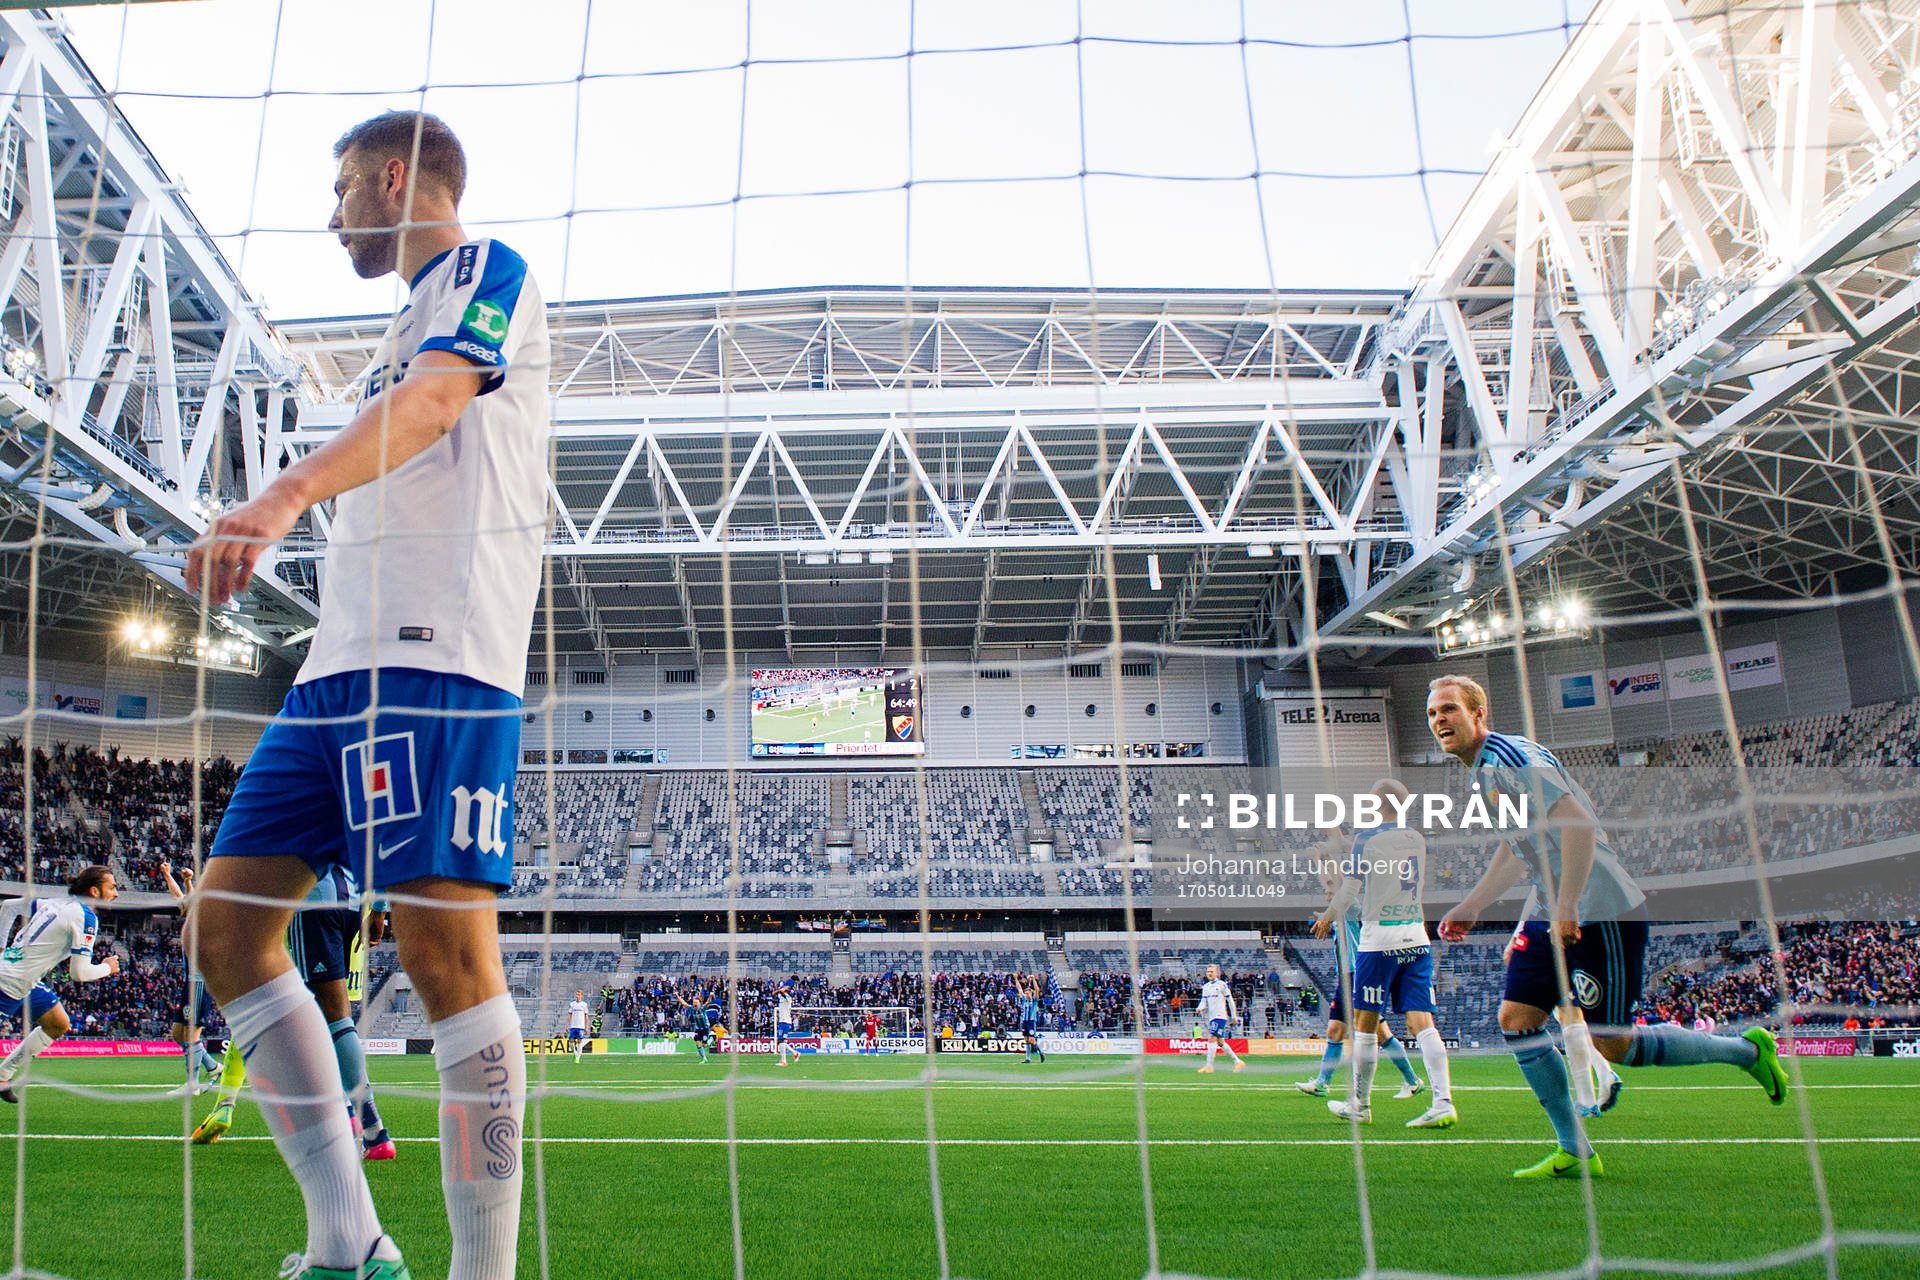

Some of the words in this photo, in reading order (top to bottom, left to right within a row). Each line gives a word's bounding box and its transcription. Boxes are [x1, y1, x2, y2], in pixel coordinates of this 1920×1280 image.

[1735, 656, 1771, 670] PEAB
[1630, 673, 1659, 684] INTER
[1631, 681, 1661, 693] SPORT
[73, 696, 101, 706] INTER
[890, 698, 917, 708] 64:49
[1333, 710, 1381, 723] Arena
[836, 743, 878, 753] Prioritet
[451, 782, 509, 858] nt
[368, 1041, 399, 1049] BOSS
[720, 1039, 774, 1053] Prioritet
[963, 1040, 1027, 1052] XL-BYGG
